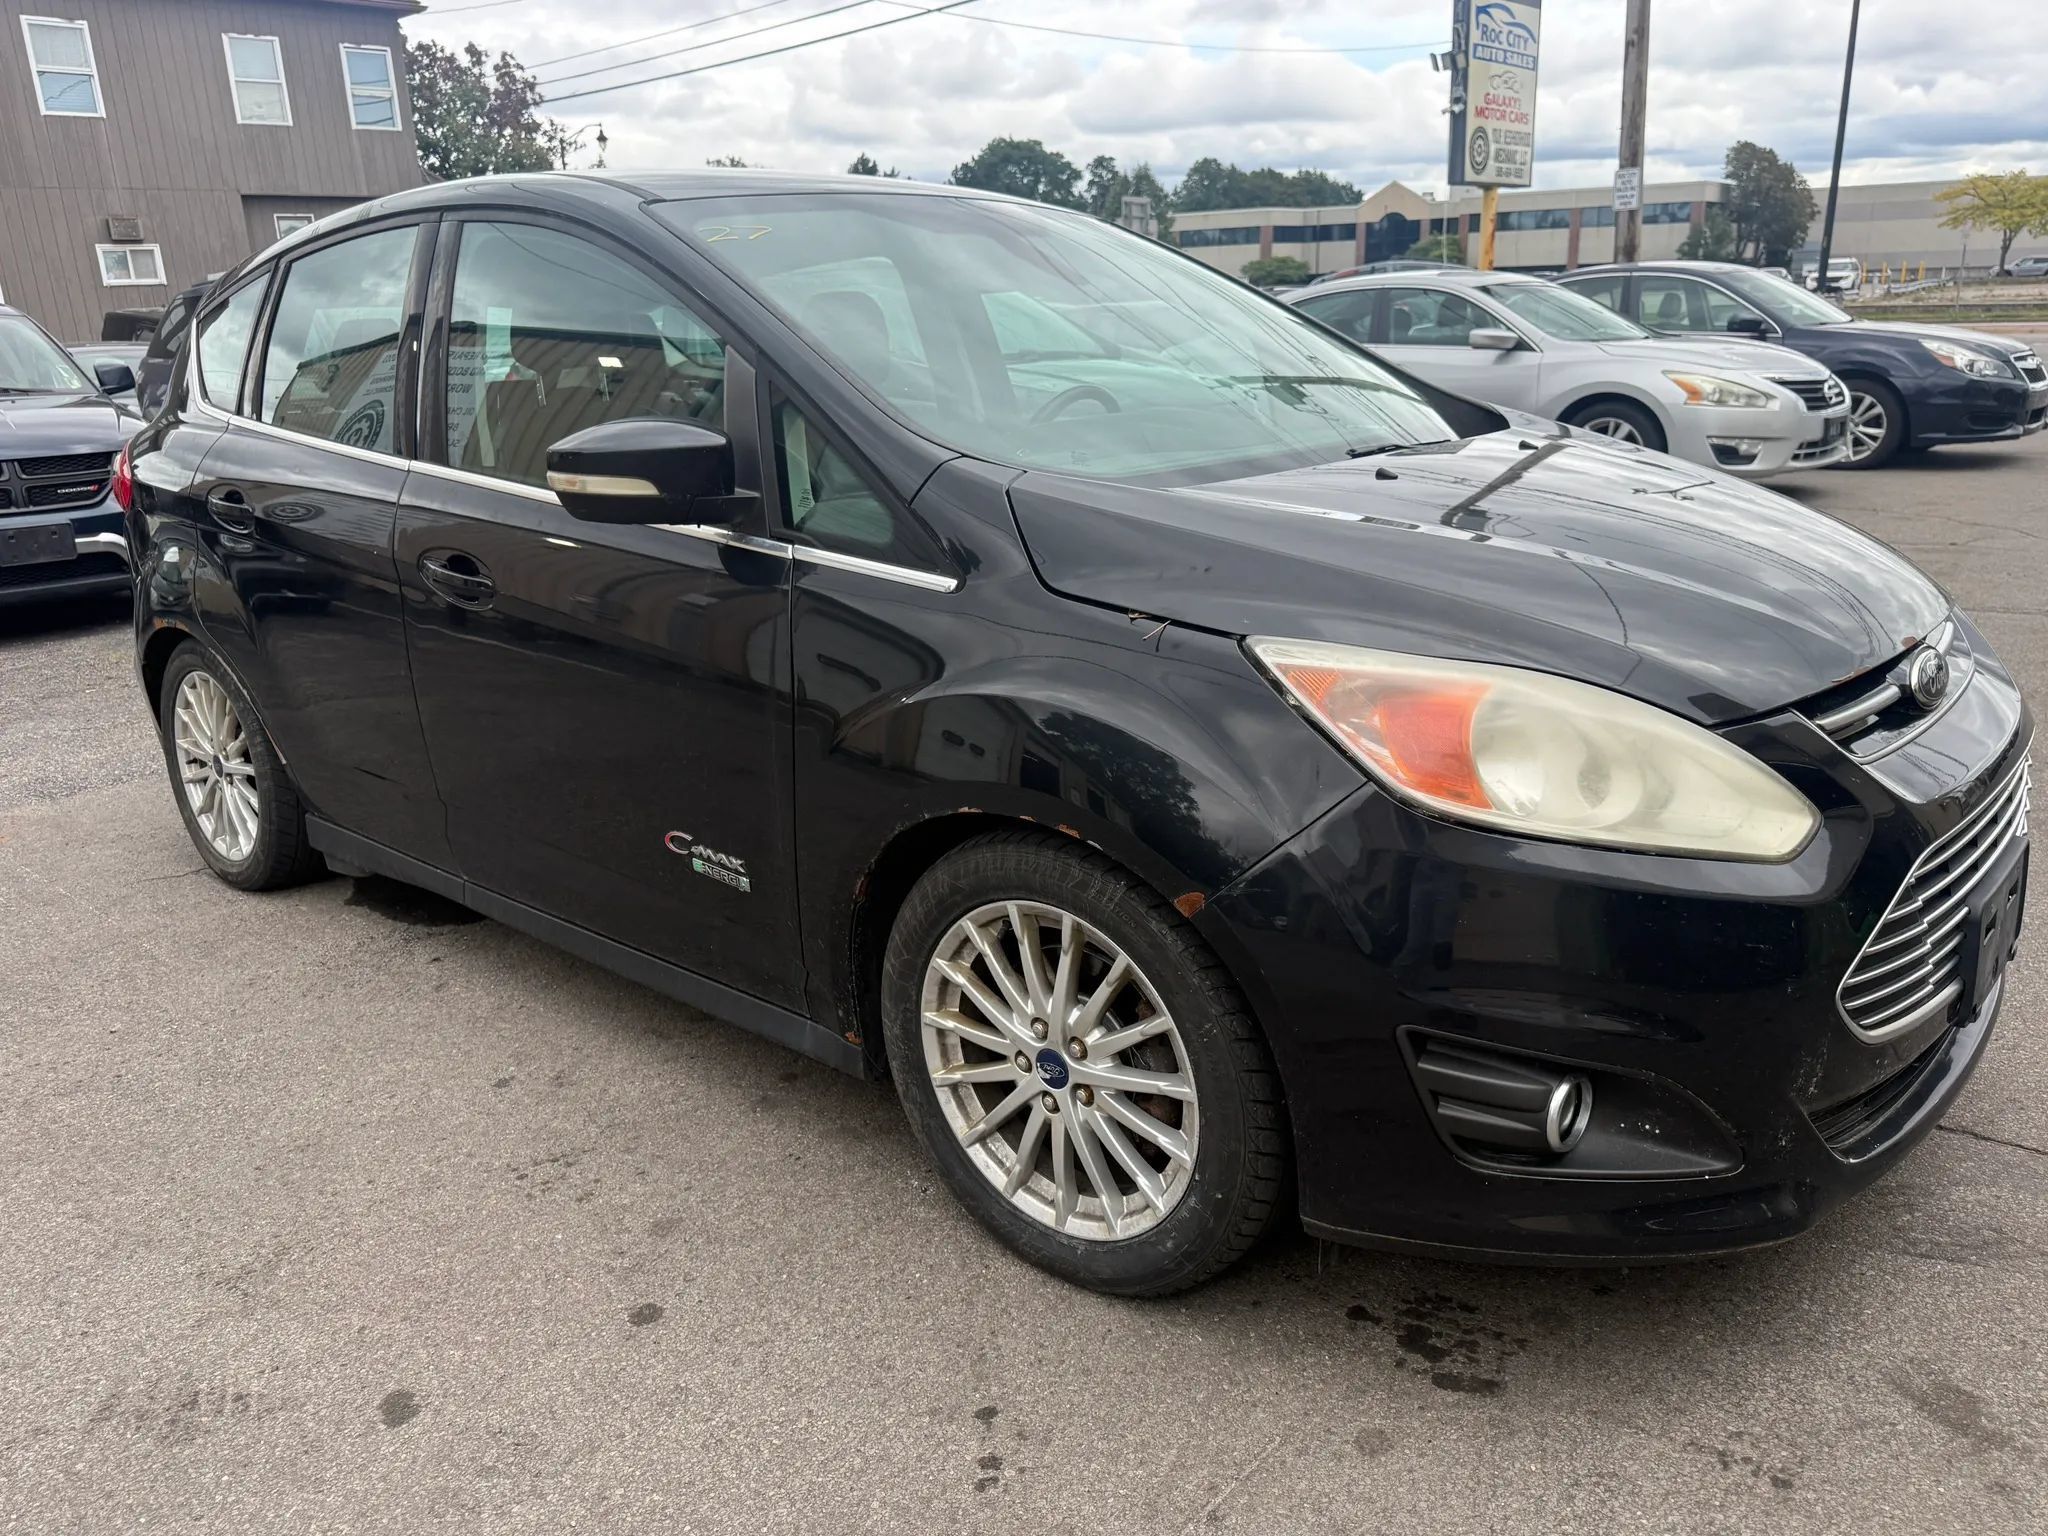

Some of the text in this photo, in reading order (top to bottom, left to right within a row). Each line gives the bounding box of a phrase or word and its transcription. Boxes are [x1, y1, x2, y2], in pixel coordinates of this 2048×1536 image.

[1481, 23, 1530, 51] ROC CITY
[1476, 45, 1534, 69] AUTO SALES
[1474, 105, 1529, 125] MOTOR CARS
